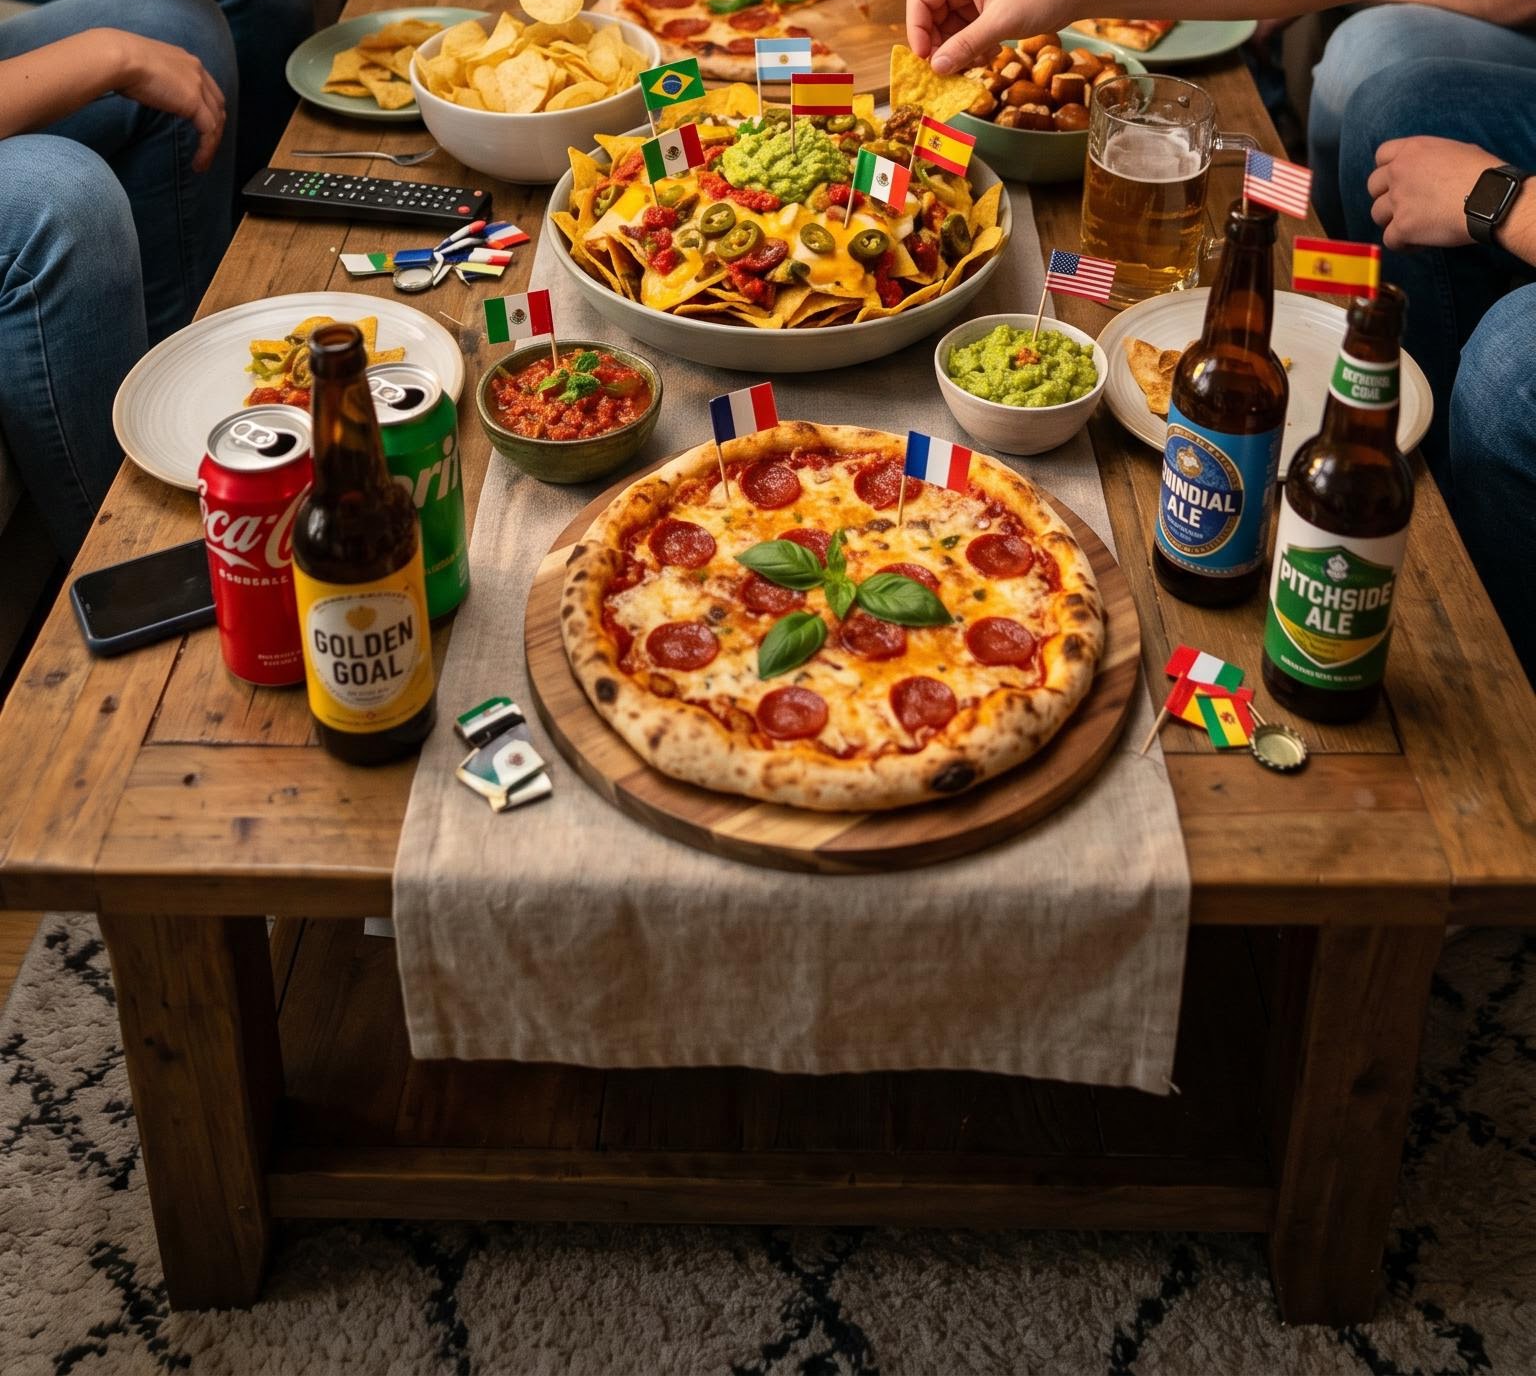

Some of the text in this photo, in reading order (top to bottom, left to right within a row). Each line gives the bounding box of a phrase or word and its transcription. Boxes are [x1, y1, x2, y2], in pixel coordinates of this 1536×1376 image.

[1167, 494, 1203, 529] ALE
[1280, 558, 1393, 612] PITCHSIDE
[314, 614, 413, 659] GOLDEN
[1305, 606, 1354, 635] ALE
[333, 655, 403, 686] GOAL
